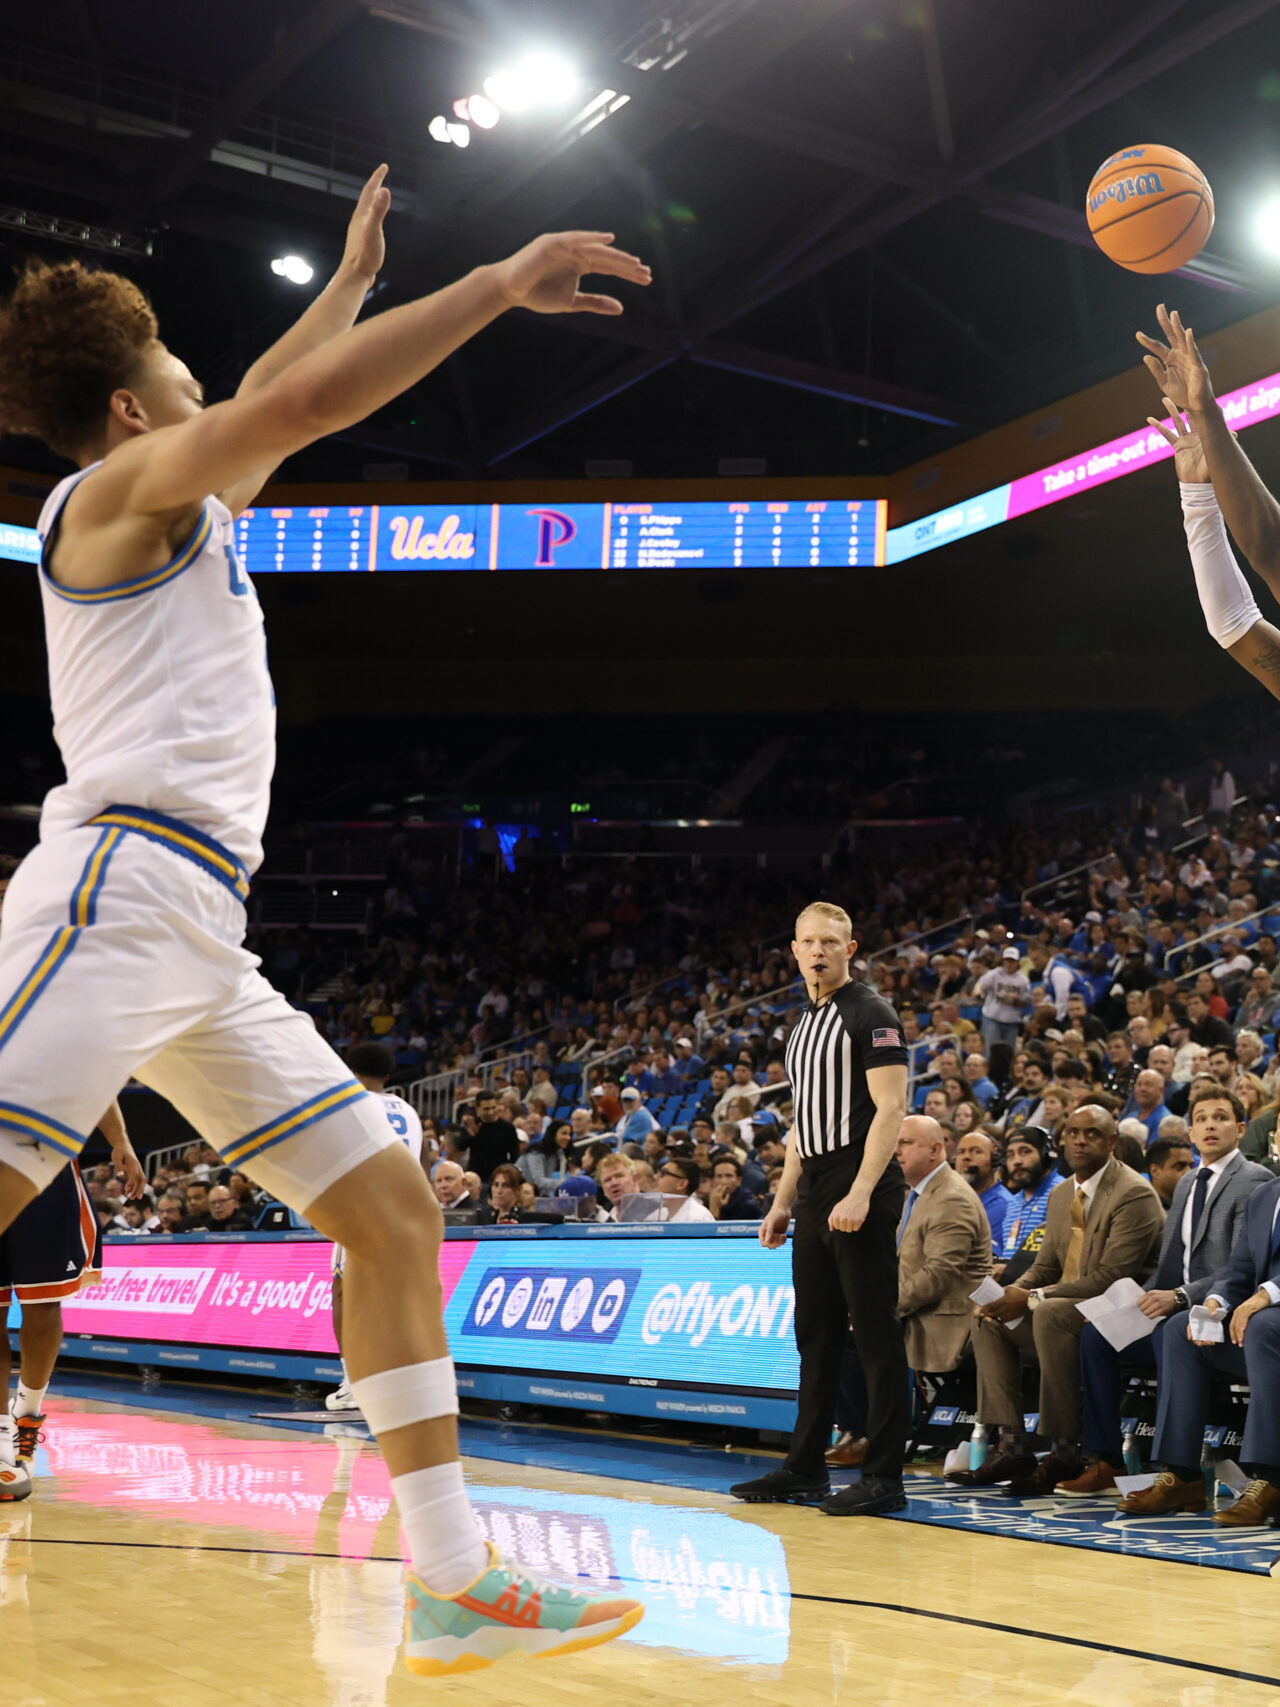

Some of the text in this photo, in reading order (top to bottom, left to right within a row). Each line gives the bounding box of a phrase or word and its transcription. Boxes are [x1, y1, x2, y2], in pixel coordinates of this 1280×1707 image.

[1089, 172, 1165, 213] Wilson
[1043, 470, 1076, 493] Take
[1076, 466, 1086, 480] a
[1087, 439, 1146, 476] time-out
[390, 514, 476, 560] Ucla
[525, 508, 577, 566] P
[147, 1271, 206, 1305] travel.
[209, 1271, 239, 1306] It's
[239, 1282, 256, 1307] a
[252, 1272, 314, 1315] good
[641, 1281, 796, 1347] @flyONT
[929, 1512, 1263, 1557] Financial
